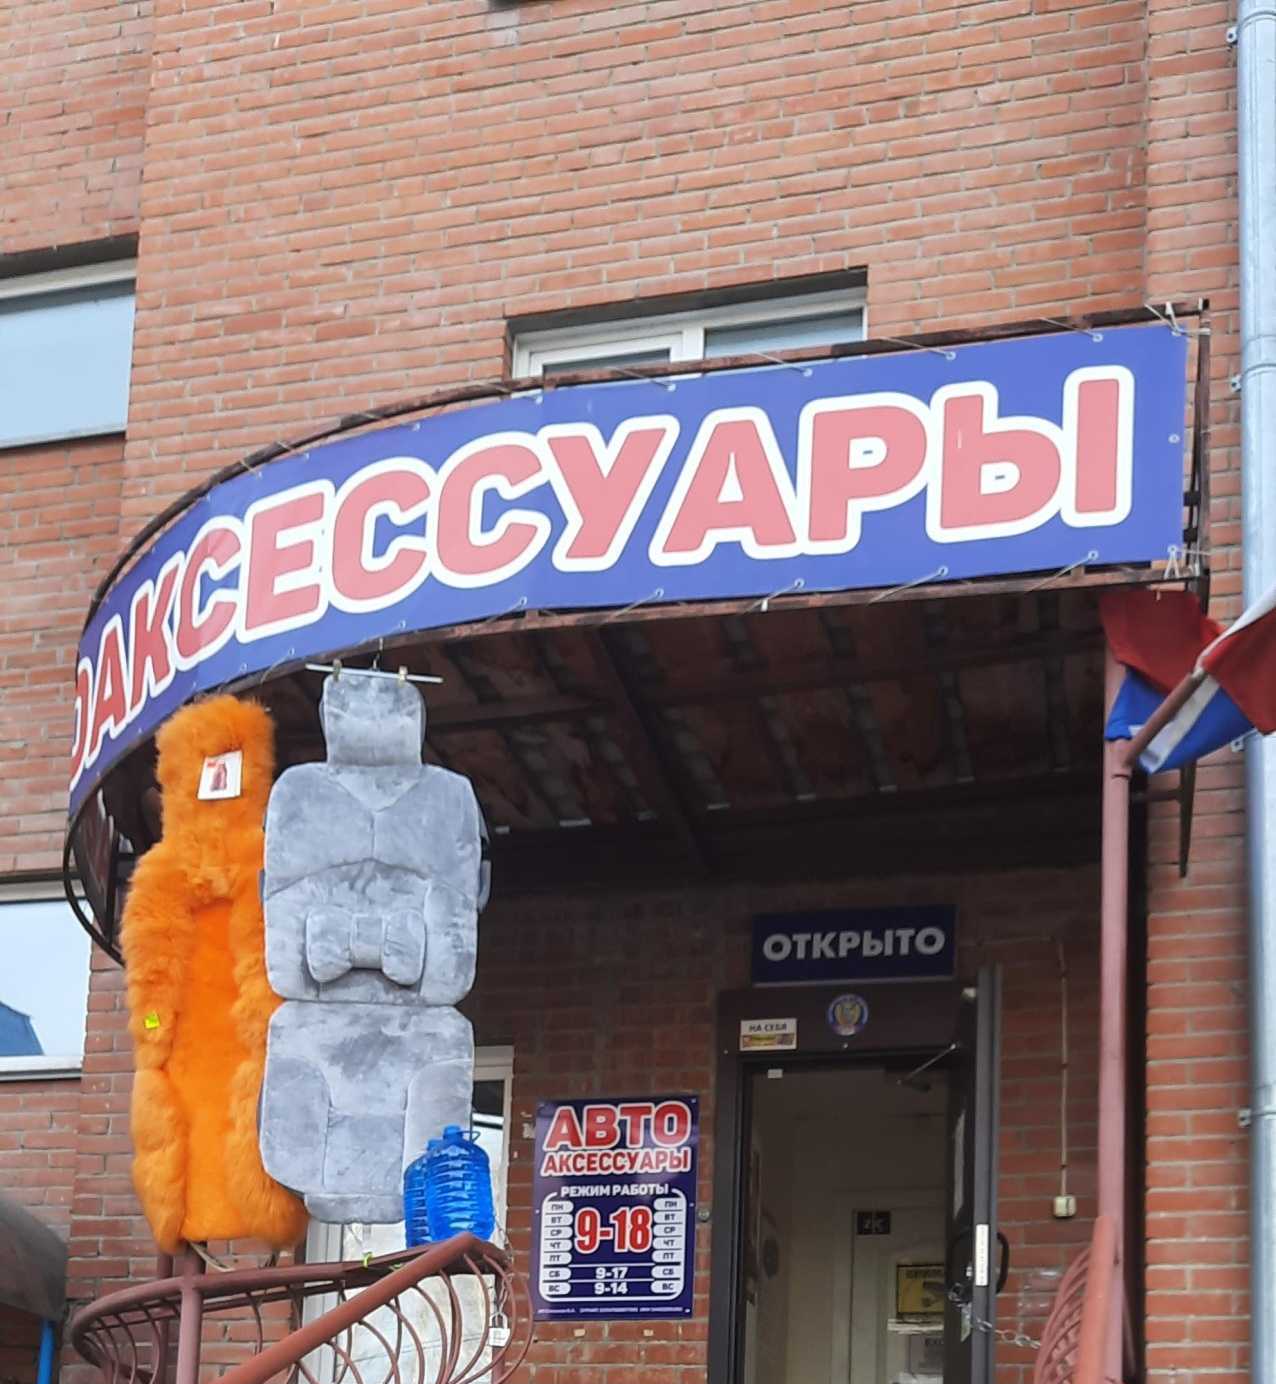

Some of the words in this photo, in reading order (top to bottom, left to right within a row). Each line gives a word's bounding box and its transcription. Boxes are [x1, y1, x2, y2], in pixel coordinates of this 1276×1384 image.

[762, 926, 946, 961] ОТКРЫТО
[749, 1022, 762, 1032] НА
[764, 1022, 788, 1031] СЕБЯ
[544, 1100, 691, 1150] АВТО
[541, 1148, 691, 1176] АКСЕССУАРЫ
[561, 1184, 611, 1197] РЕЖИМ
[613, 1183, 668, 1196] РАБОТЫ
[551, 1203, 564, 1211] ПН
[574, 1206, 653, 1254] 9-18
[662, 1252, 674, 1260] ПТ
[596, 1267, 628, 1279] 9-17
[594, 1282, 628, 1294] 9-14
[661, 1282, 673, 1290] ВС
